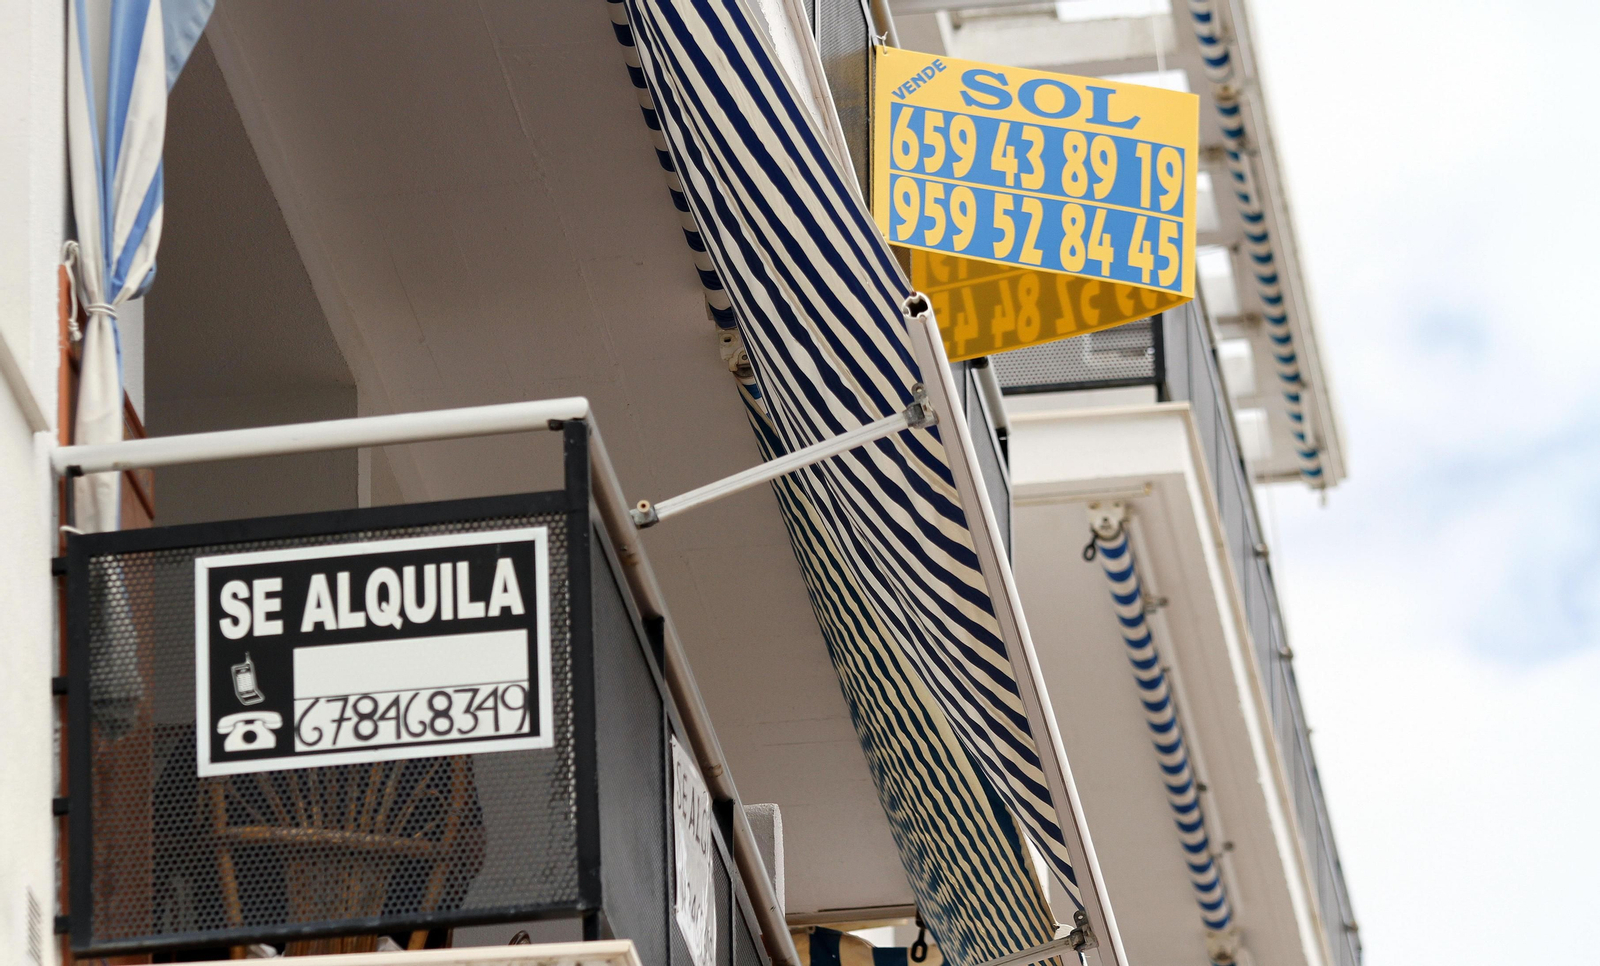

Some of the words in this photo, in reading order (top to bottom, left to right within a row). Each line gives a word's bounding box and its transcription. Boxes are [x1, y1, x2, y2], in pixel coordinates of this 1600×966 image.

[891, 58, 947, 101] VENDE
[959, 68, 1141, 130] SOL
[892, 107, 977, 178] 659
[990, 121, 1046, 190] 43
[1061, 130, 1118, 200] 89
[1135, 142, 1183, 212] 19
[893, 176, 977, 252] 959
[992, 192, 1044, 265] 52
[1059, 203, 1114, 277] 84
[1127, 215, 1180, 287] 45
[219, 577, 284, 640] SE
[300, 557, 525, 633] ALQUILA
[295, 683, 529, 746] 678468349
[676, 761, 688, 820] SE
